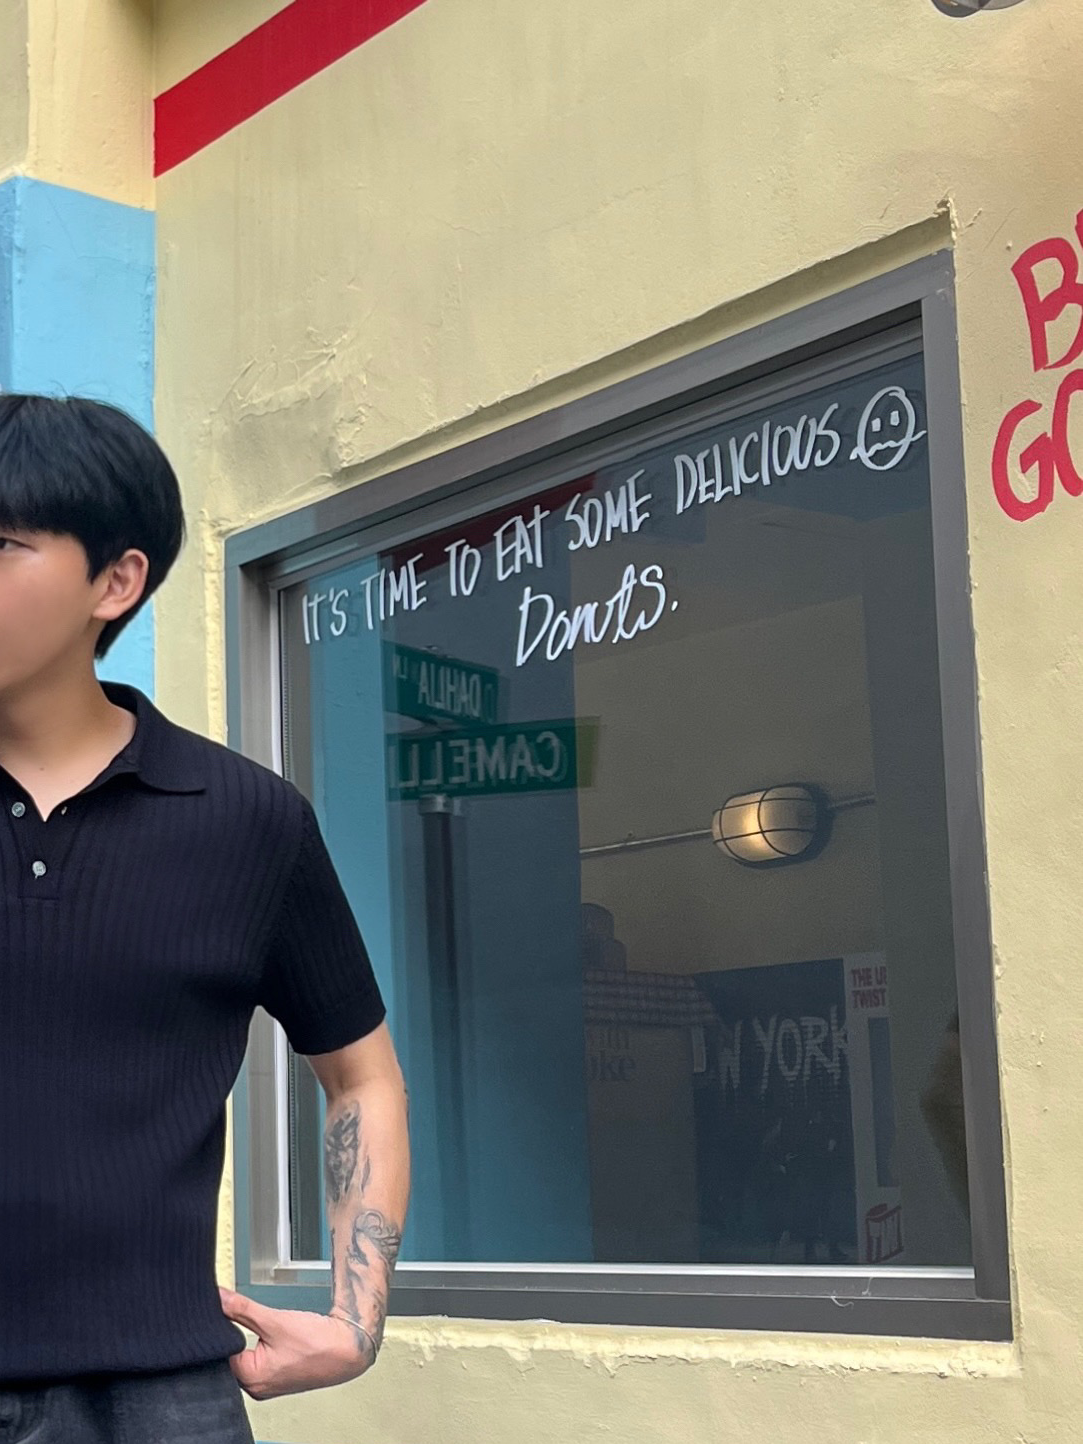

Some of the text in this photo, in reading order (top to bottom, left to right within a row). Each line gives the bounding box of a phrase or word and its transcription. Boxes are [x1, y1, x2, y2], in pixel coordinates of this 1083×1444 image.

[1011, 206, 1083, 372] B
[302, 402, 842, 644] IT'S TIME TO EAT SOME DELICIOUS
[852, 988, 887, 1009] TWIST
